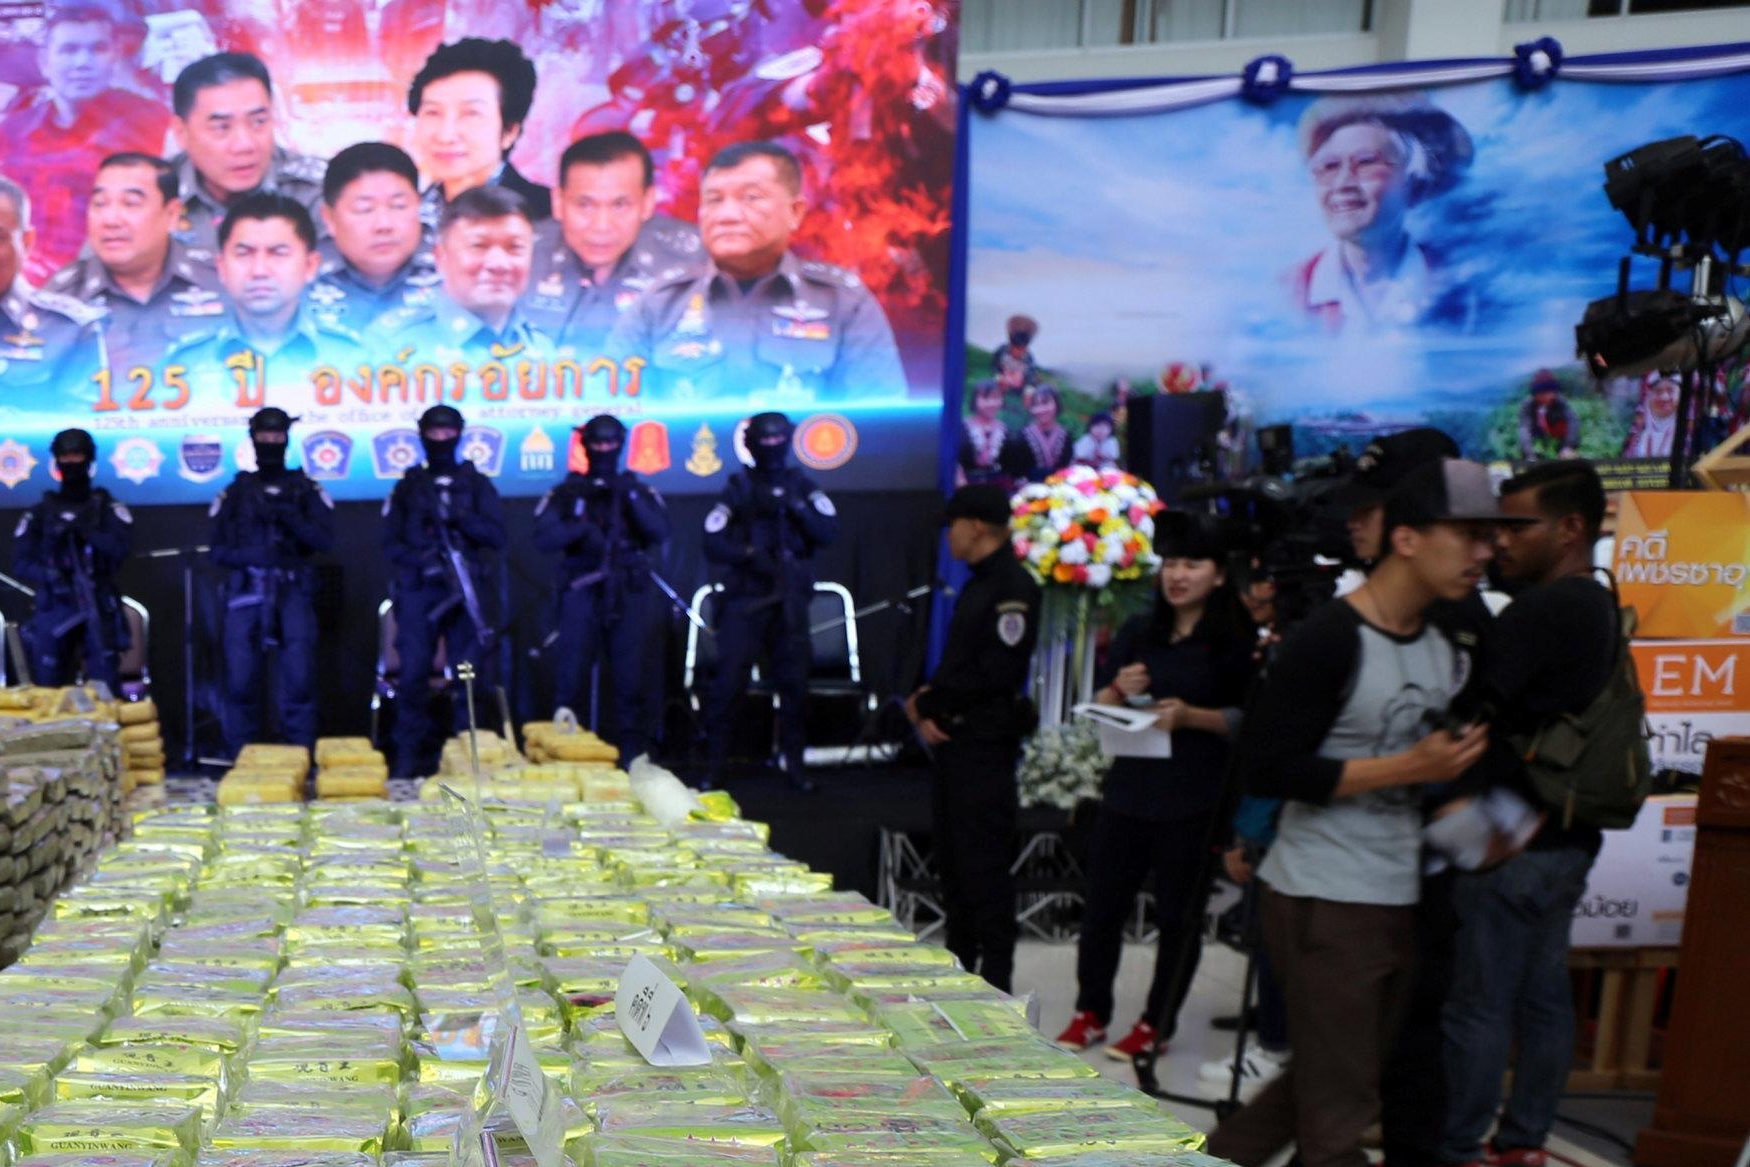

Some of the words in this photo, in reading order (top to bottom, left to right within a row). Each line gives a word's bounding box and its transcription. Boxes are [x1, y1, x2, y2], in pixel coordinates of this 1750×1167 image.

[91, 364, 191, 412] 125
[225, 348, 266, 408] ปี
[310, 341, 647, 406] องค์กรอัยการ
[1617, 527, 1670, 561] คดี
[1651, 654, 1739, 696] EM
